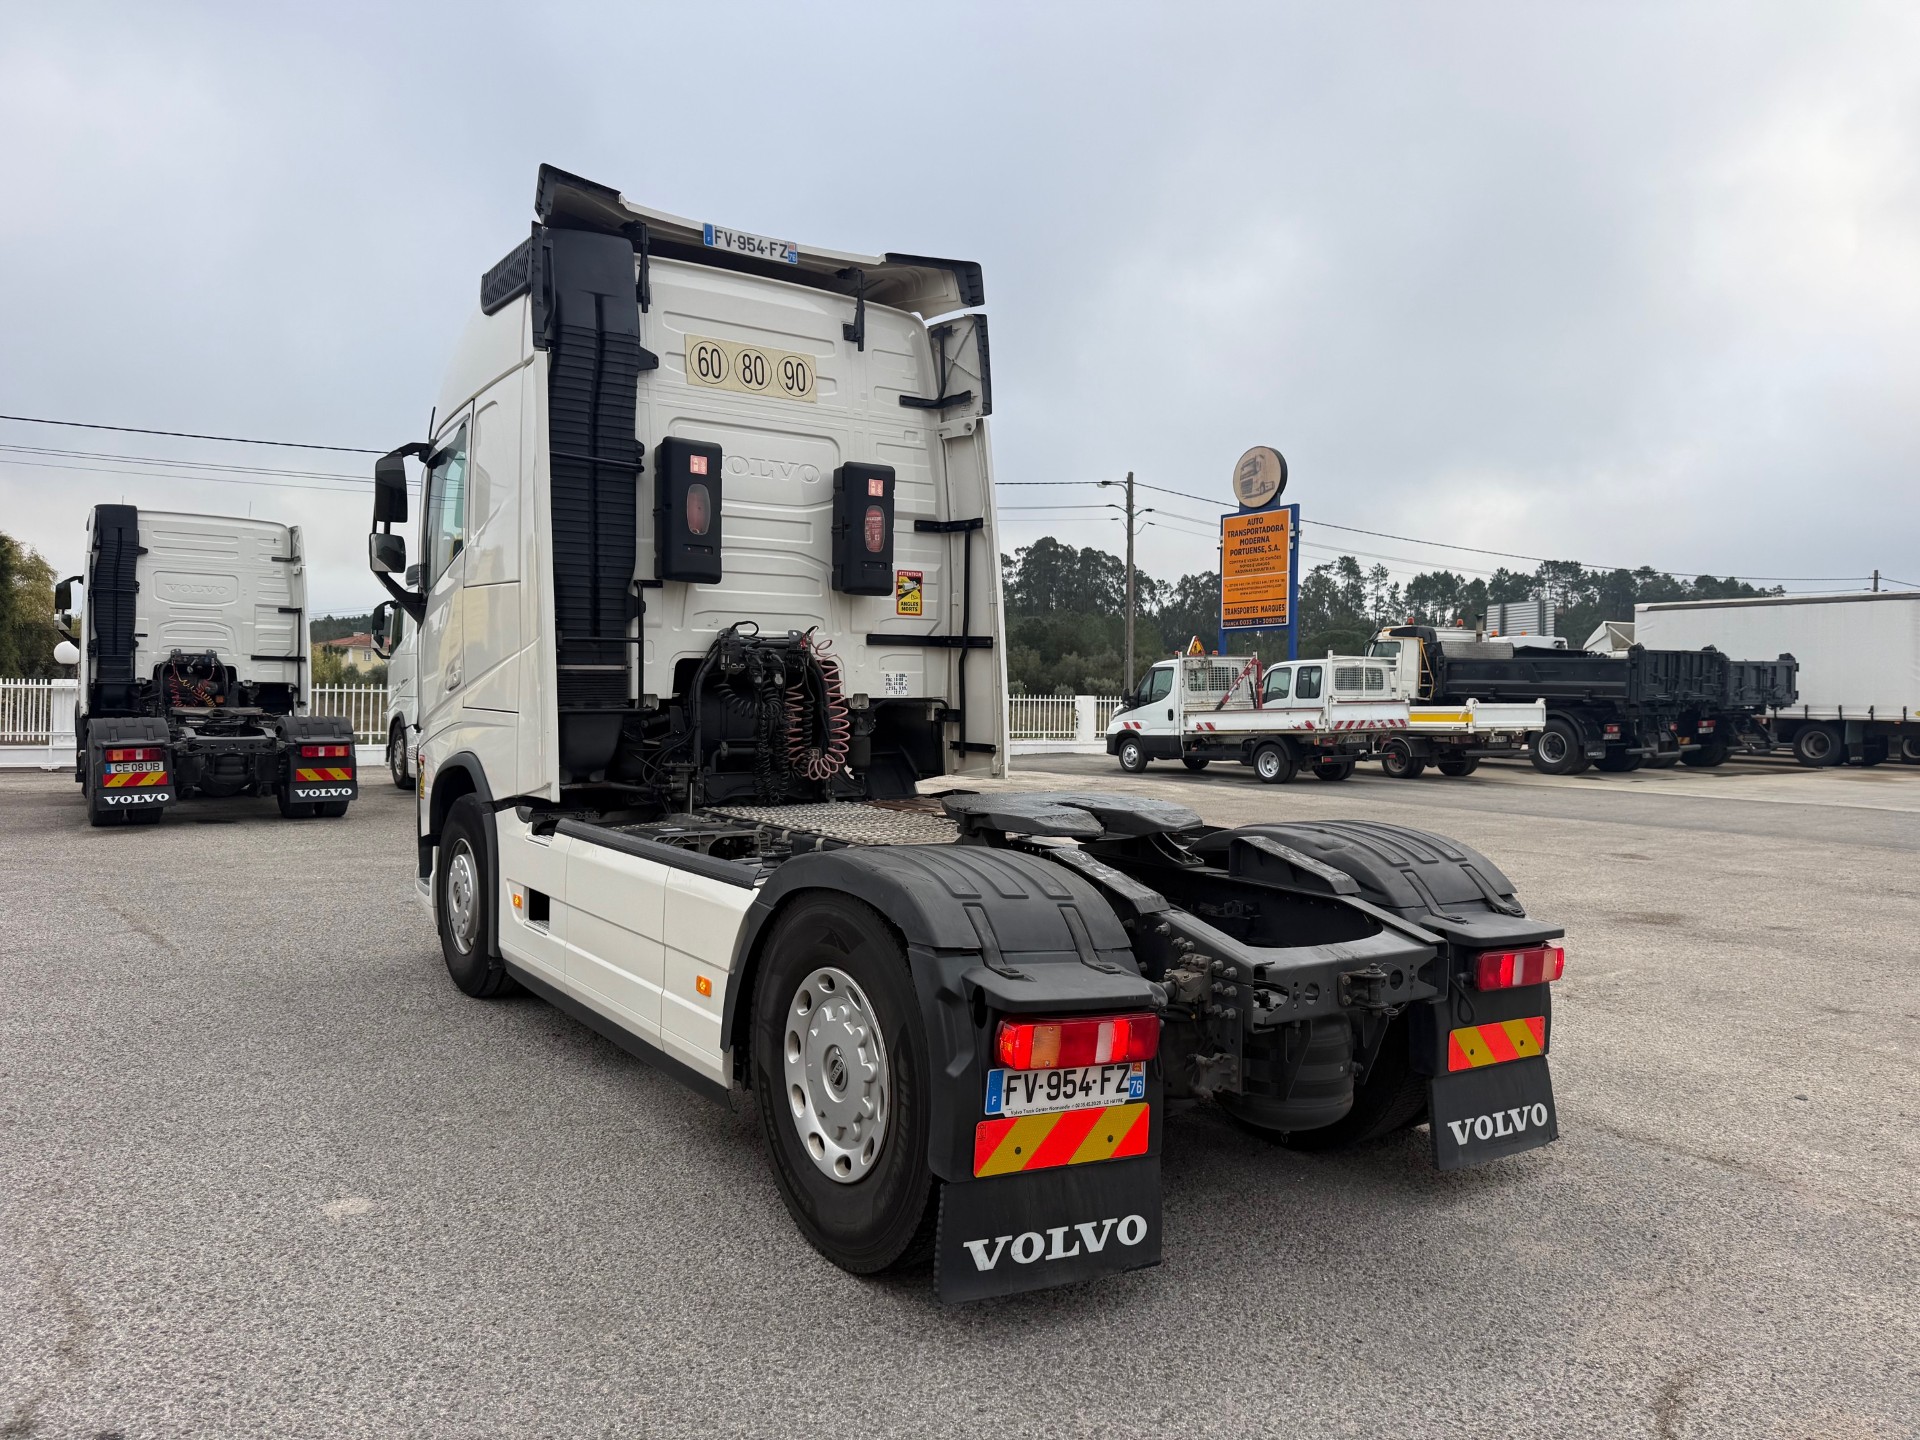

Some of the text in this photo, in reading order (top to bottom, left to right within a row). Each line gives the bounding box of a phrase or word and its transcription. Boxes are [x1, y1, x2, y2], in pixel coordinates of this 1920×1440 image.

[714, 229, 788, 259] FV-954-FZ
[698, 346, 806, 392] 60 80 90
[722, 455, 820, 483] OLVO
[1247, 517, 1264, 526] AUTO
[1227, 524, 1285, 538] TRANSPORTADORA
[1240, 535, 1270, 546] MODERNA
[1230, 544, 1281, 557] PORTUENSE, S.A.
[164, 583, 228, 595] VOLVO
[1225, 604, 1285, 615] TRANSPORTES MARQUES
[104, 793, 170, 805] VOLVO
[295, 788, 353, 798] VOLVO
[1005, 1064, 1130, 1106] FV-954-FZ
[1130, 1080, 1143, 1095] 76
[991, 1096, 997, 1106] F
[1447, 1102, 1548, 1146] VOLVO
[963, 1214, 1148, 1272] VOLVO
